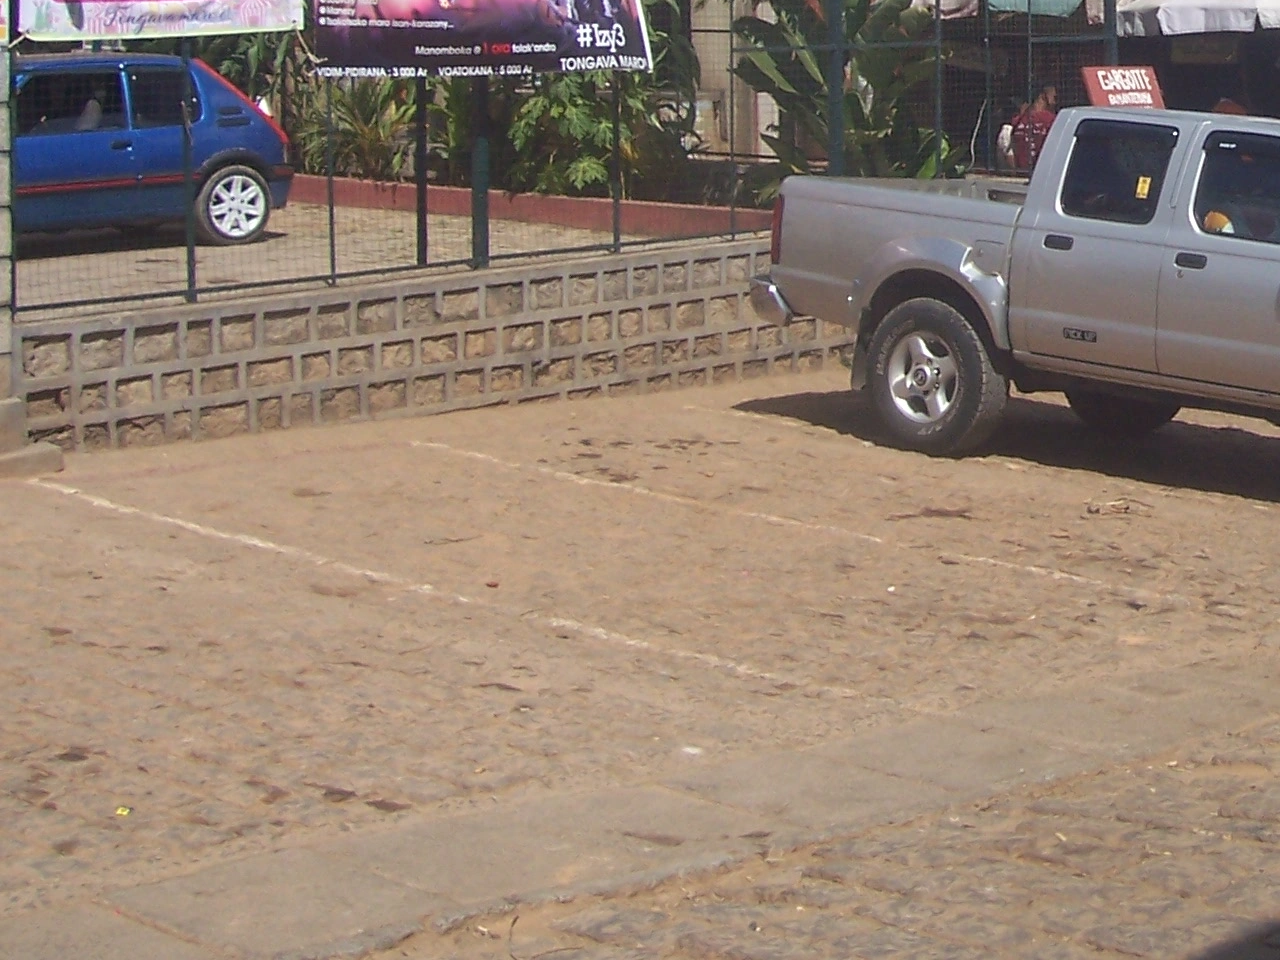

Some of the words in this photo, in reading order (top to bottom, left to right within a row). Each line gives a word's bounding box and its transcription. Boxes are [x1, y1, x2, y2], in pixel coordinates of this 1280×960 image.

[577, 23, 625, 52] #Izy3
[439, 65, 493, 76] VOATOKANA
[560, 56, 618, 71] TONGAVA
[1097, 69, 1152, 90] GARGOTTE
